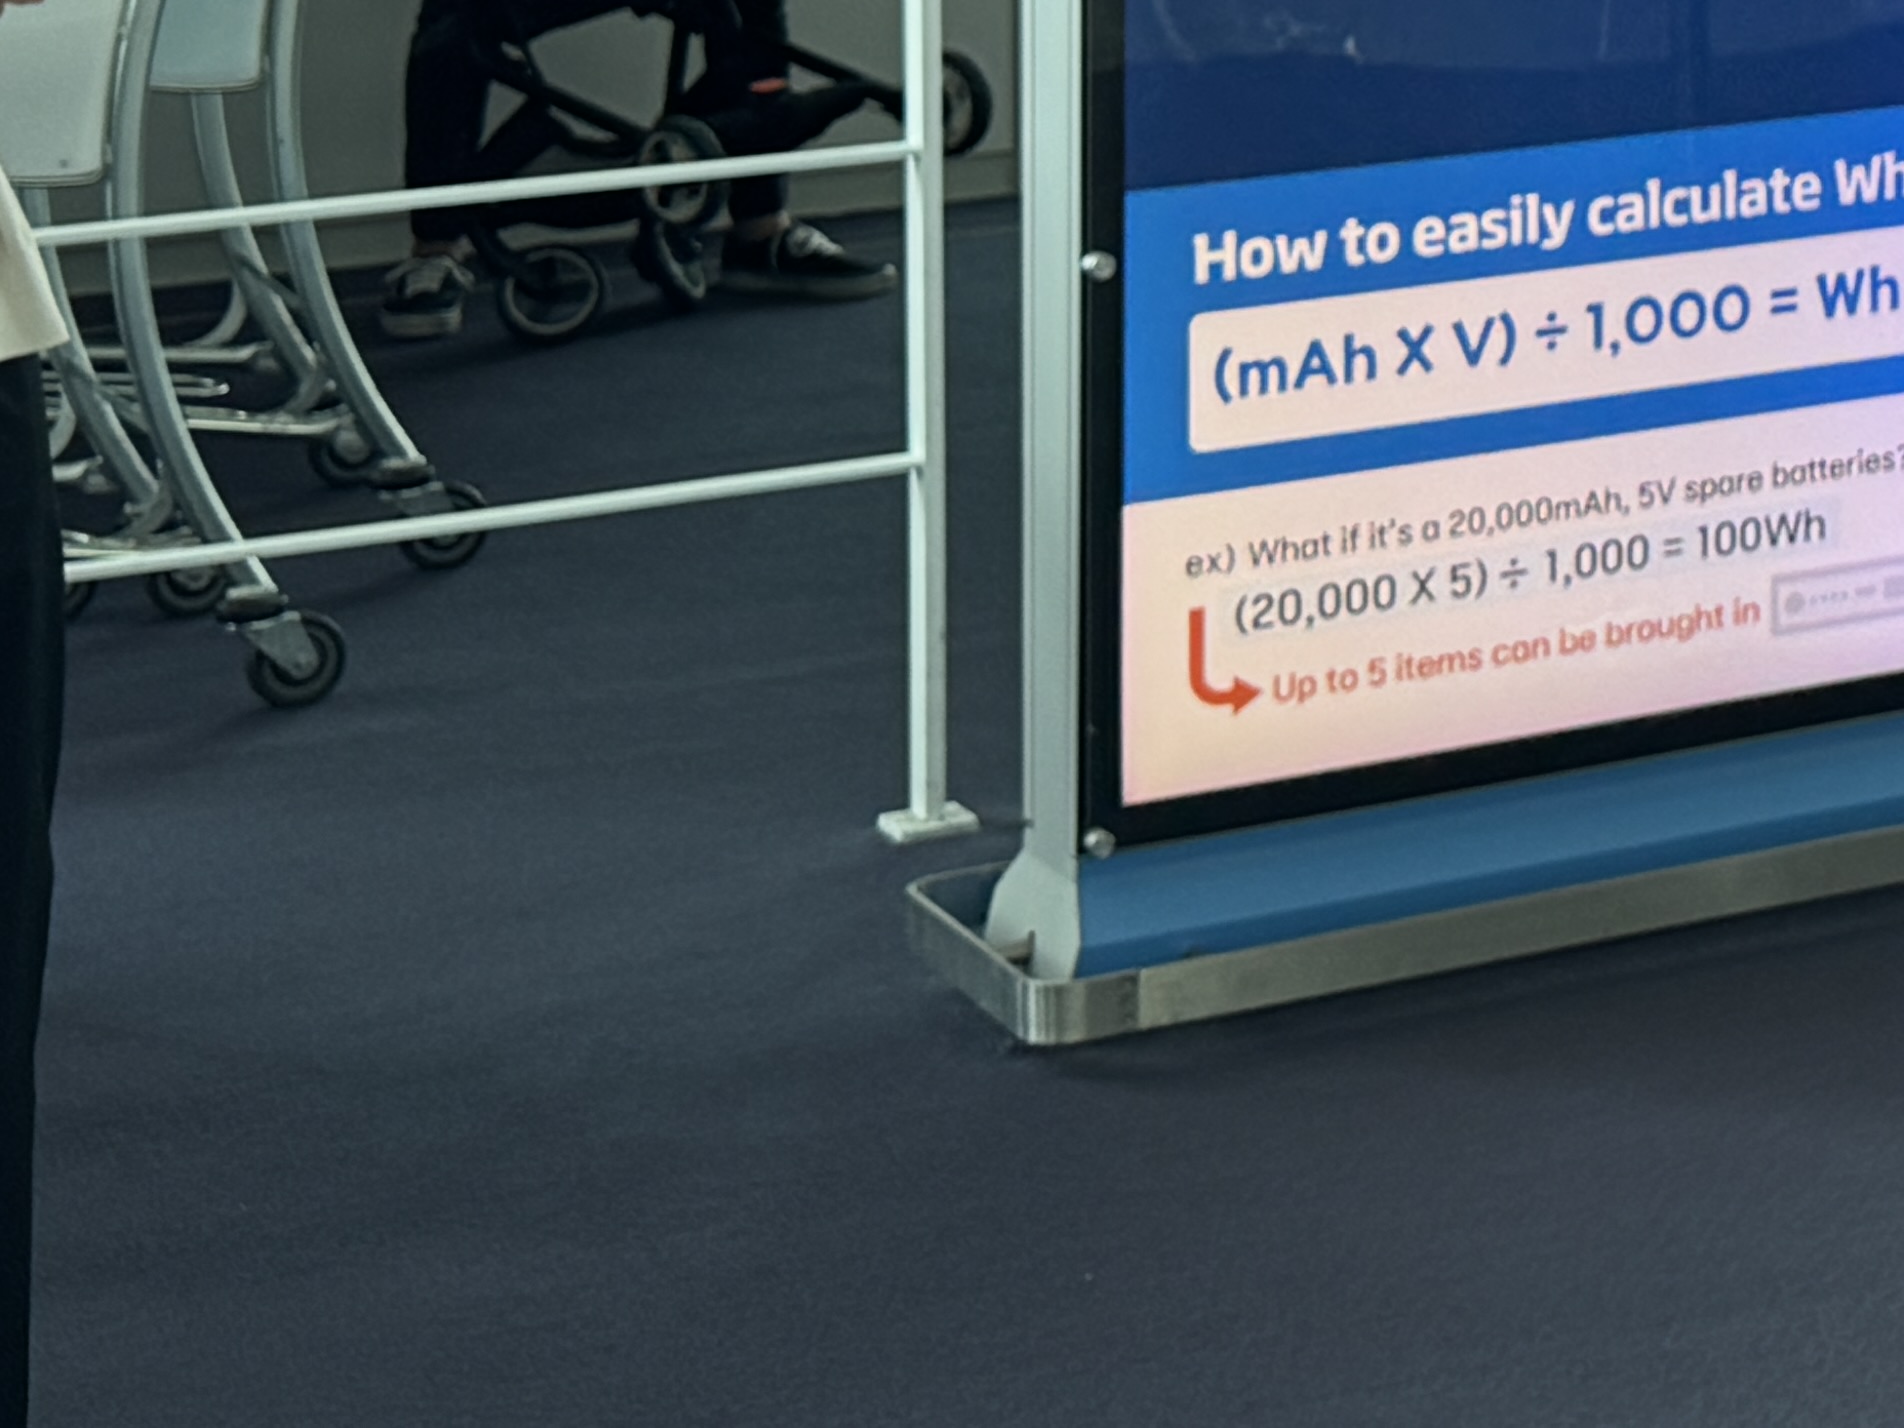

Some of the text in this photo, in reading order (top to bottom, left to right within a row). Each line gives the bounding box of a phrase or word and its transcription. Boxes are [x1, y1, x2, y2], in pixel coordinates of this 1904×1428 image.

[1194, 228, 1326, 284] How
[1340, 217, 1400, 267] to
[1412, 192, 1574, 256] easily
[1587, 164, 1823, 234] calculate
[1213, 329, 1379, 404] (mAh
[1397, 325, 1434, 376] X
[1457, 310, 1517, 368] V)
[1586, 283, 1750, 357] 1,000
[1817, 265, 1899, 320] Wh
[1185, 543, 1236, 577] ex)
[1249, 530, 1329, 568] What
[1340, 524, 1360, 555] if
[1368, 518, 1412, 550] it's
[1422, 520, 1440, 540] a
[1448, 488, 1630, 541] 20,000mAh,
[1637, 478, 1676, 509] 5V
[1685, 466, 1763, 507] spare
[1234, 573, 1398, 635] (20,000
[1410, 569, 1436, 605] X
[1448, 560, 1490, 601] 5)
[1545, 533, 1652, 588] 1,000
[1697, 508, 1827, 562] 100Wh
[1273, 597, 1761, 704] Up to 5 items can be brought in
